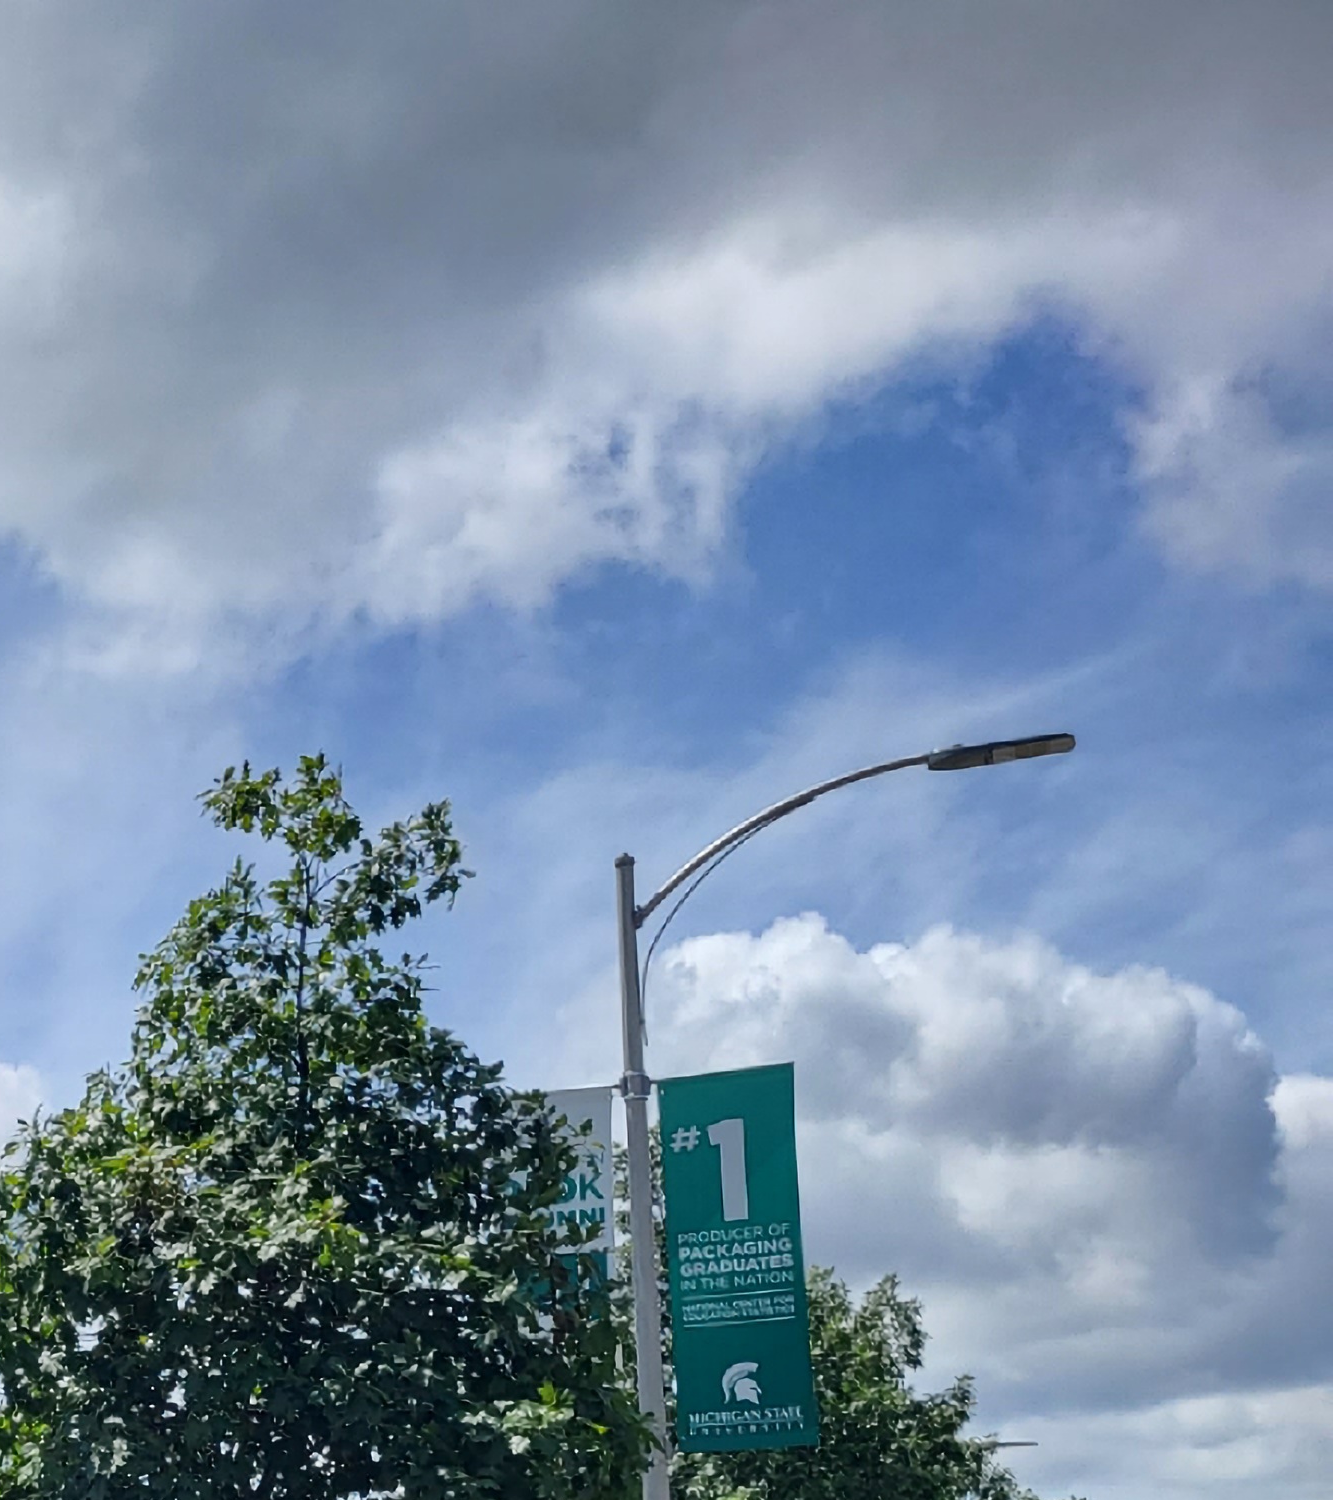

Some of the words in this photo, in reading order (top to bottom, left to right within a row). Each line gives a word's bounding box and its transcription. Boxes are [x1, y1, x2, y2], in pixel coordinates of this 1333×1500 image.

[670, 1118, 748, 1221] #1
[678, 1225, 764, 1244] PRODUCER
[768, 1223, 791, 1236] OF
[678, 1237, 792, 1261] PACKAGING
[680, 1253, 794, 1277] GRADUATES
[680, 1280, 697, 1291] IN
[699, 1276, 730, 1290] THE
[734, 1270, 794, 1287] NATION
